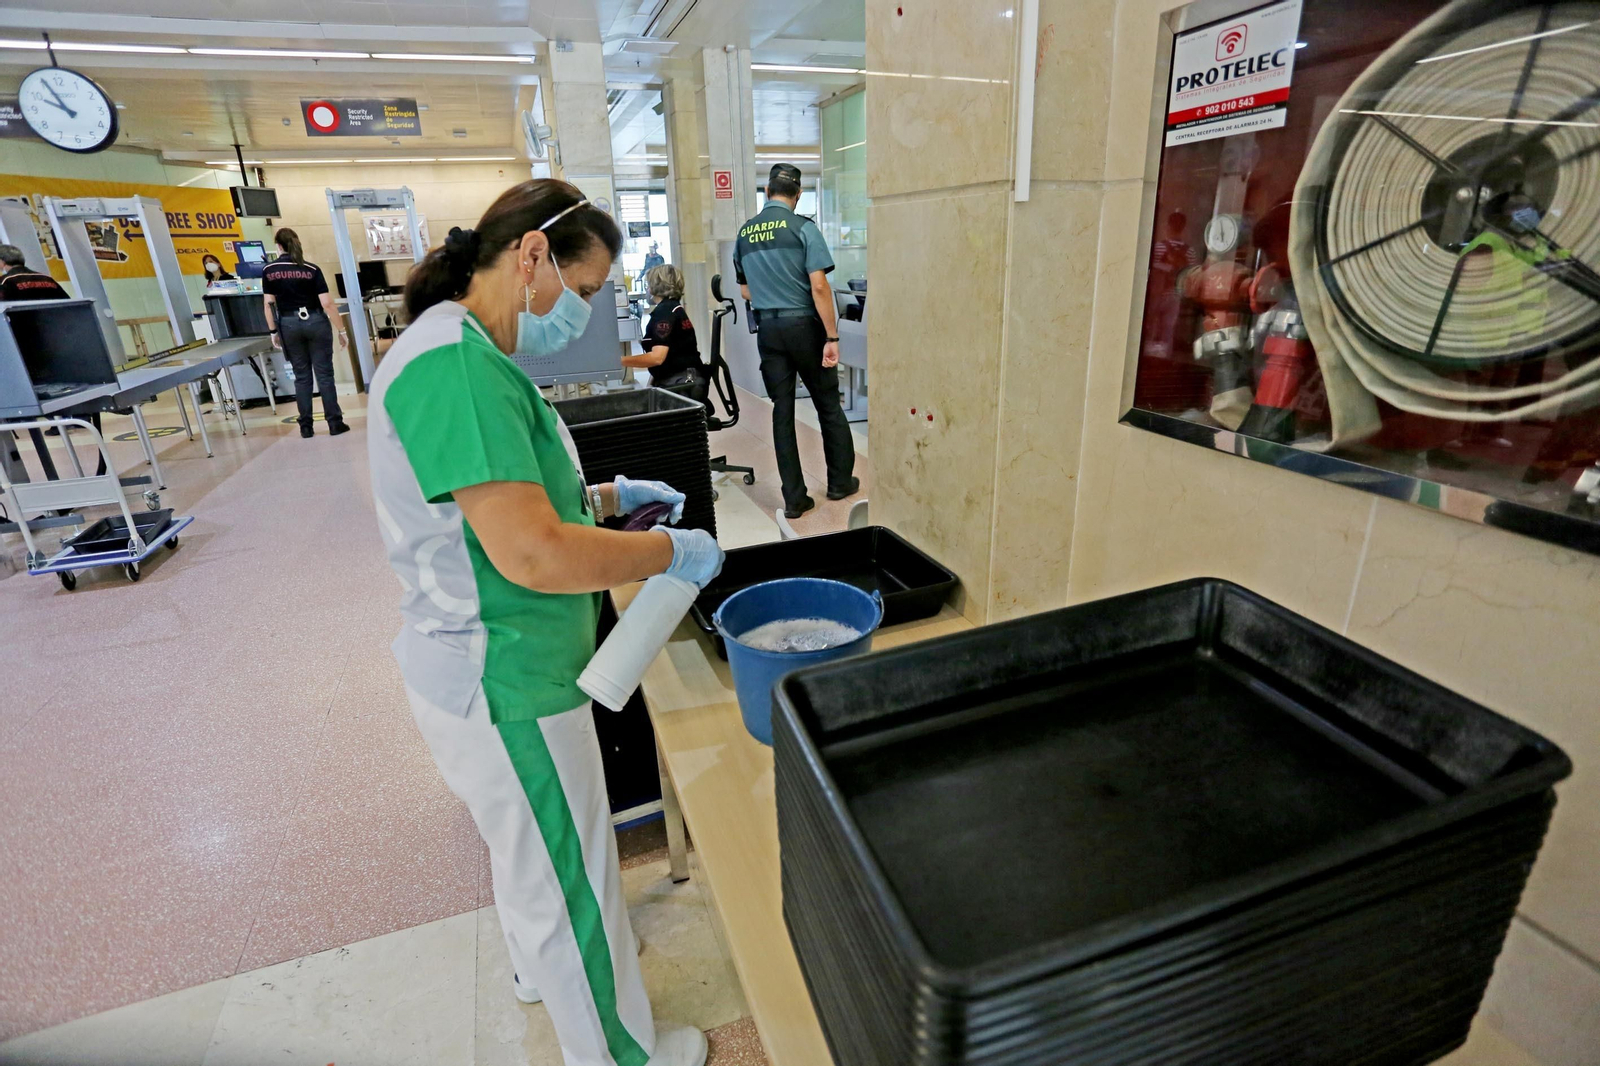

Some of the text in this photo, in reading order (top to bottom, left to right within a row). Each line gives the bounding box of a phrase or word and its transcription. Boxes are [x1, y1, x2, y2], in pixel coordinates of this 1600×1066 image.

[1176, 48, 1288, 92] PROTELEC
[53, 76, 64, 86] 12
[74, 81, 79, 91] 1
[31, 91, 43, 101] 10
[87, 91, 95, 101] 2
[31, 105, 38, 115] 9
[1205, 96, 1254, 115] 902 010 543
[97, 106, 105, 116] 3
[347, 108, 368, 116] Security
[41, 120, 49, 130] 8
[97, 120, 105, 129] 4
[56, 130, 63, 140] 7
[89, 131, 96, 141] 5
[1175, 133, 1196, 141] CENTRAL
[1197, 126, 1225, 137] RECEPTORA
[1234, 121, 1259, 129] ALARMAS
[74, 134, 82, 144] 6
[195, 212, 236, 229] SHOP
[740, 220, 787, 237] GUARDIA
[749, 231, 775, 243] CIVIL
[266, 271, 313, 281] SEGURIDAD
